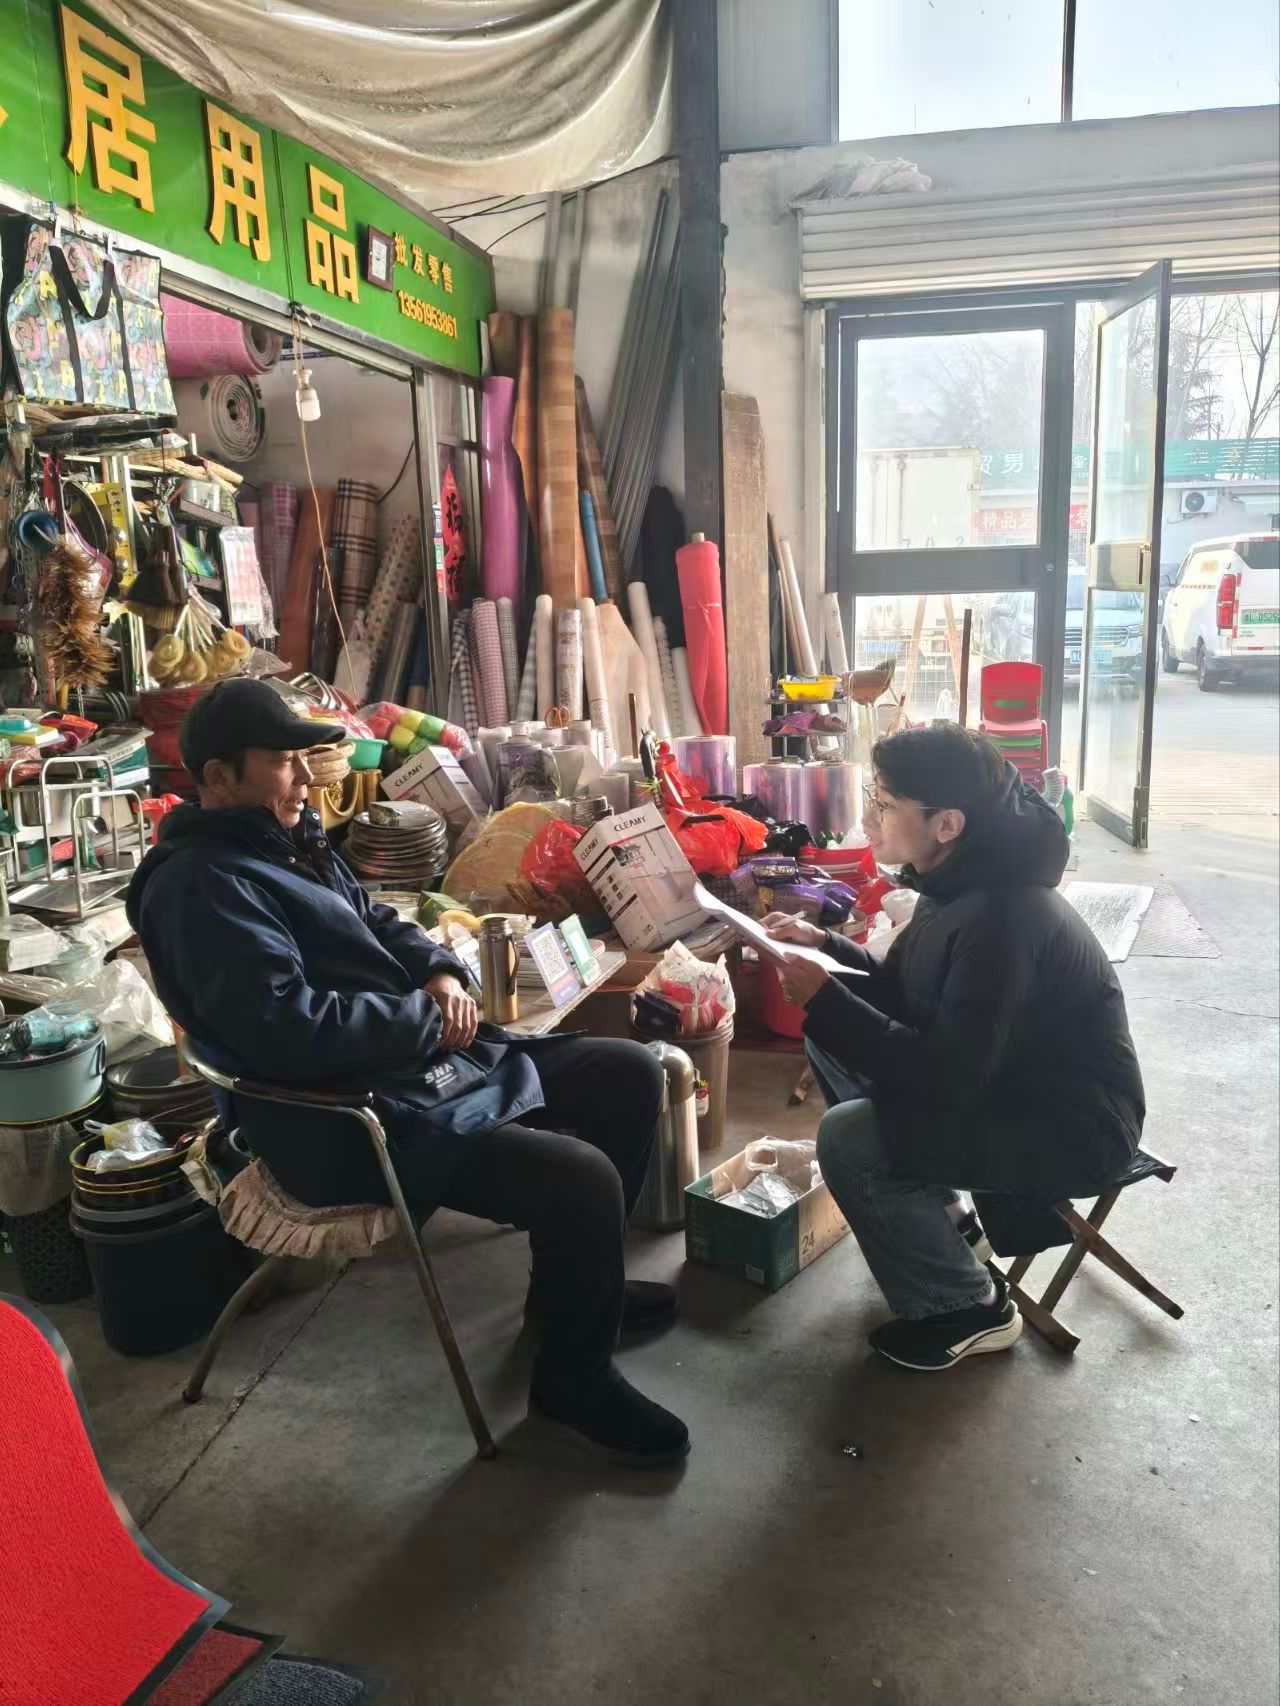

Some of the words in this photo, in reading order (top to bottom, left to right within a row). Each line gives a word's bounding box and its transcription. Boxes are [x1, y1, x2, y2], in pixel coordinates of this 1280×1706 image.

[0, 4, 361, 304] 居用品
[394, 231, 453, 294] 批发零售
[394, 761, 425, 787] CLEAMY
[614, 816, 646, 832] CLEAMY
[580, 839, 599, 860] CLEAMY
[802, 1230, 816, 1253] 24
